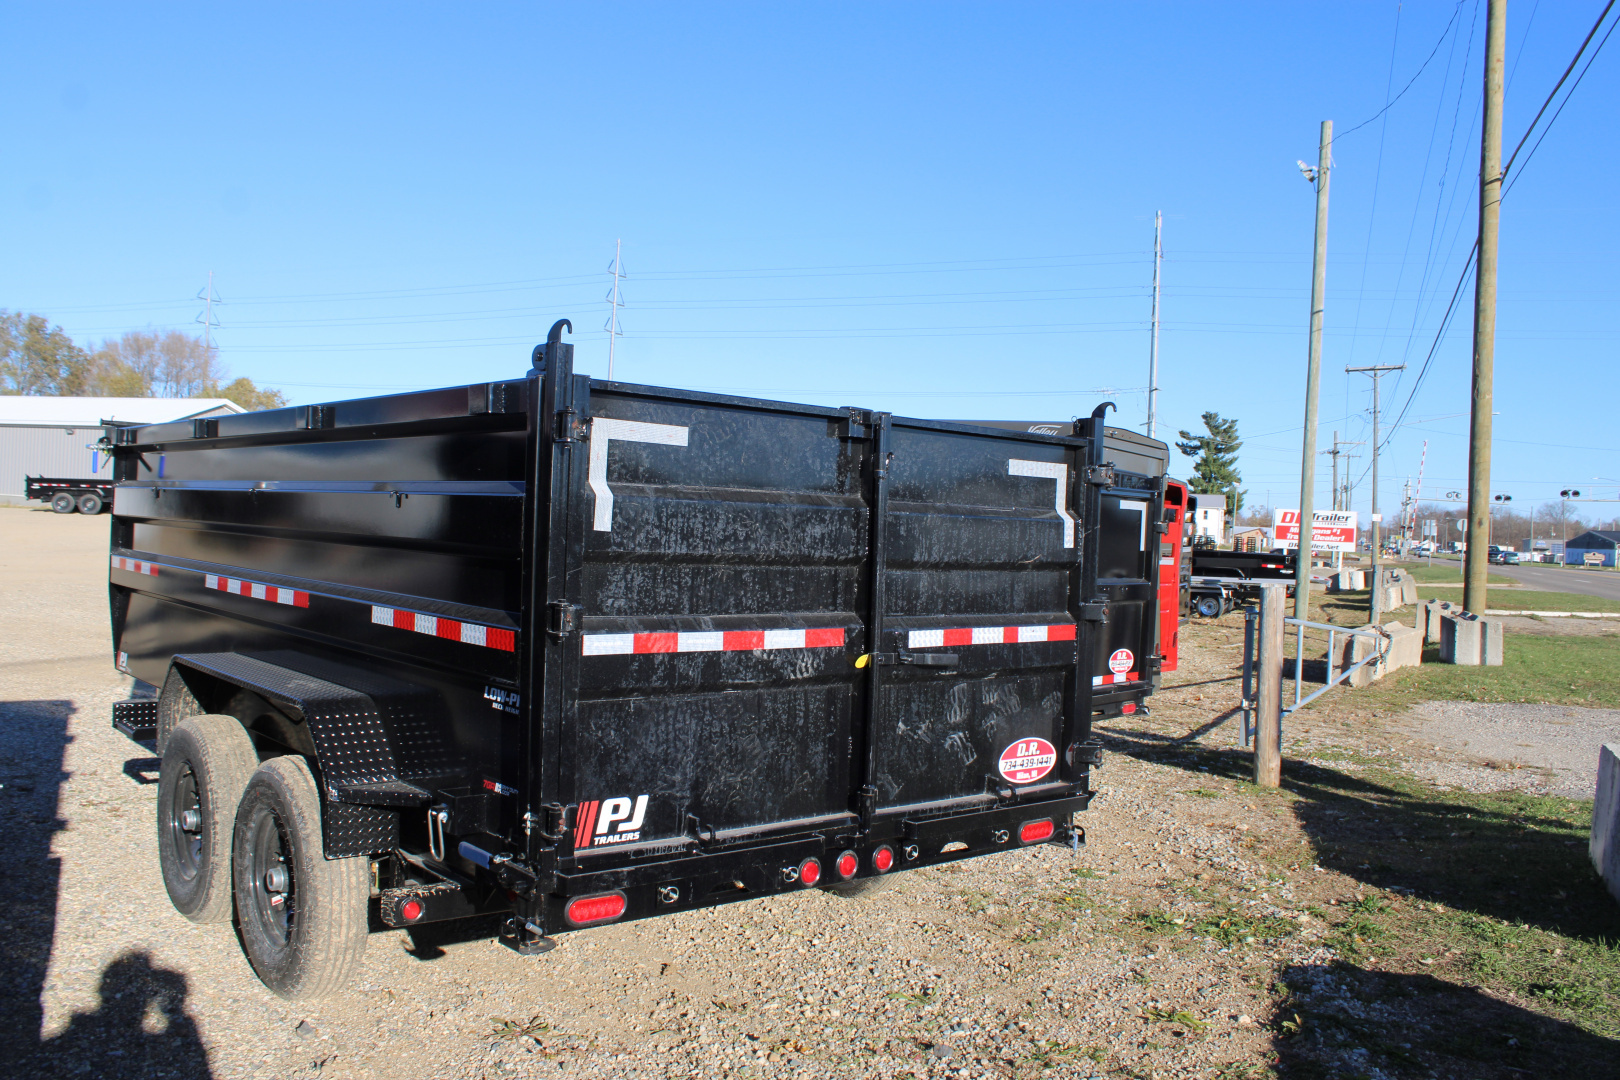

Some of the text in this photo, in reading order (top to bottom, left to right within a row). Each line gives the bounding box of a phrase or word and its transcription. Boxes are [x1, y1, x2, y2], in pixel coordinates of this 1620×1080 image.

[1016, 741, 1040, 757] D.R.
[1003, 756, 1052, 770] 734-439-1441
[596, 794, 649, 834] PJ
[594, 831, 640, 845] TRAILERS
